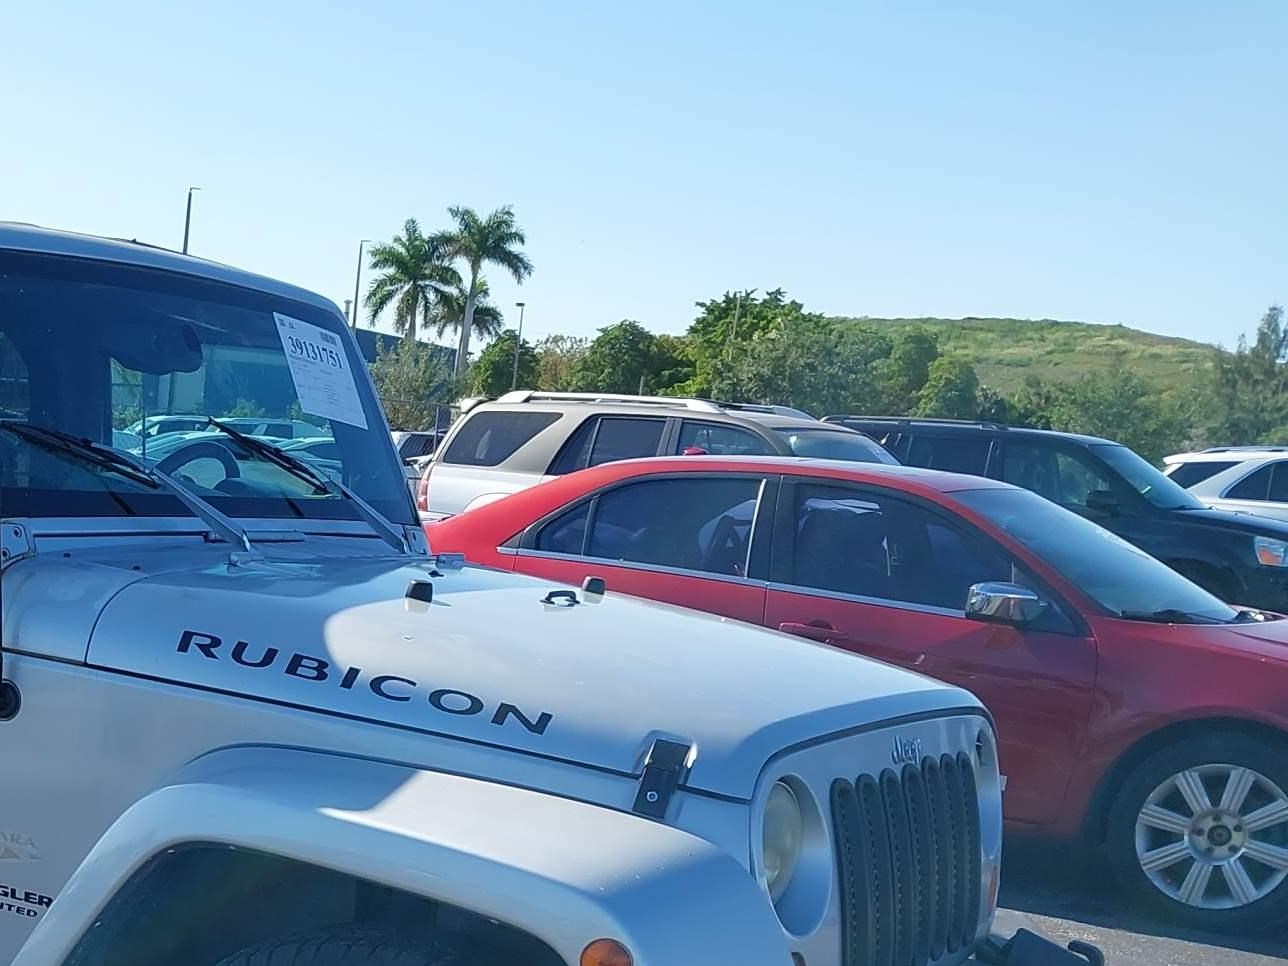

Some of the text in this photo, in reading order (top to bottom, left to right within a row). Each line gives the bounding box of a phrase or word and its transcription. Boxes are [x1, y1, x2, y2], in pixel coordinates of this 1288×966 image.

[288, 335, 343, 369] 39131751
[175, 630, 554, 736] RUBICON
[891, 735, 922, 765] Jeep
